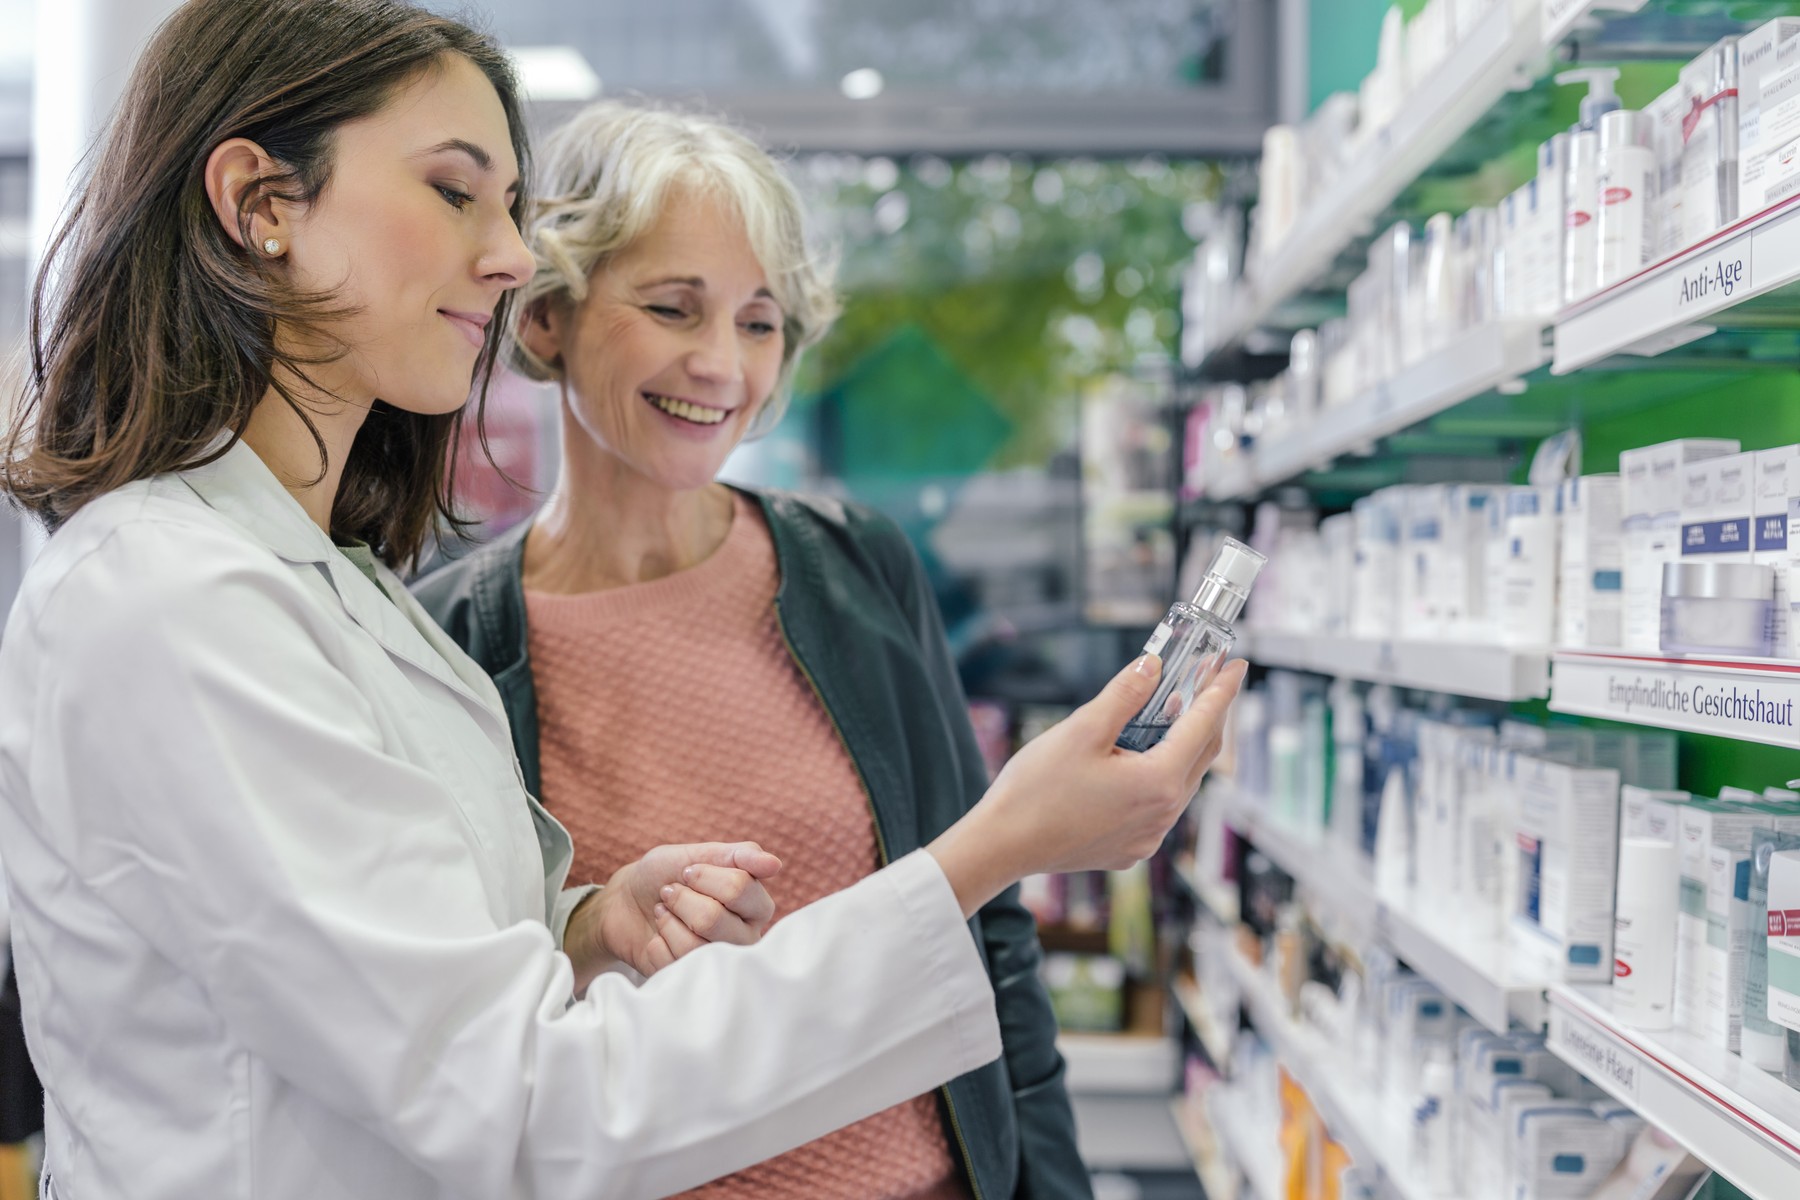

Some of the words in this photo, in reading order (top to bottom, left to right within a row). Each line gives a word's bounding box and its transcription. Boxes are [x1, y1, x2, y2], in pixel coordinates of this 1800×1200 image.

[1679, 259, 1742, 306] Anti-Age
[1608, 676, 1689, 713] Empfindliche
[1693, 685, 1793, 727] Gesichtshaut
